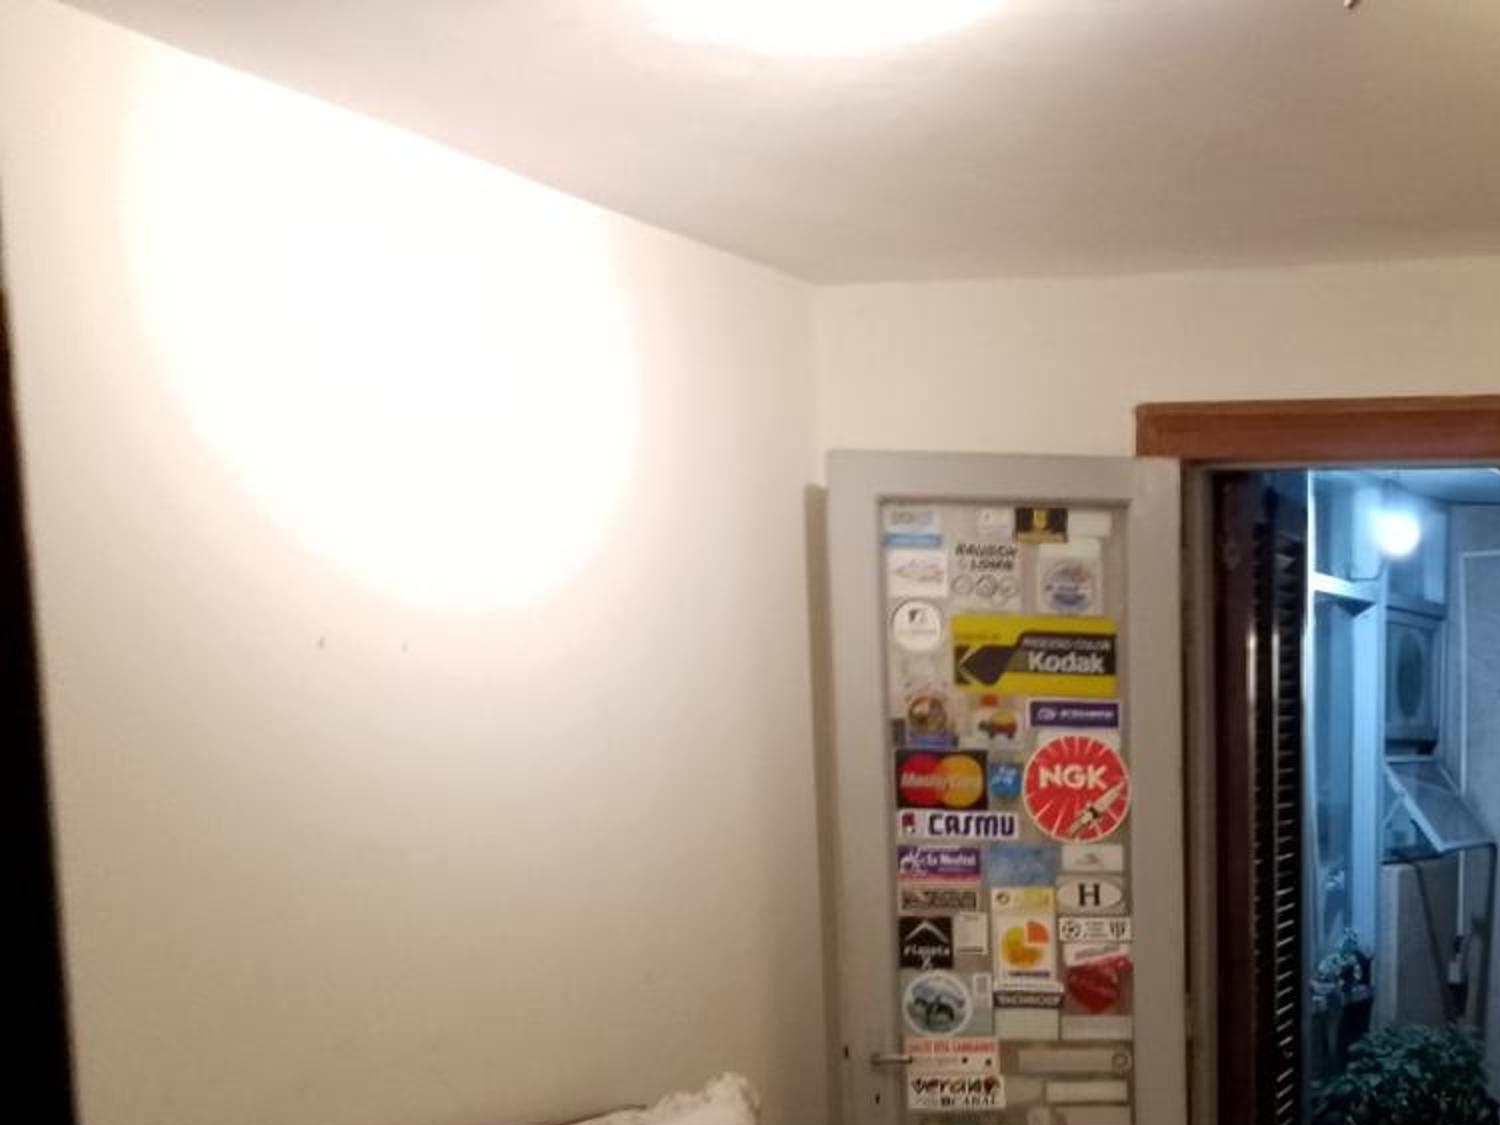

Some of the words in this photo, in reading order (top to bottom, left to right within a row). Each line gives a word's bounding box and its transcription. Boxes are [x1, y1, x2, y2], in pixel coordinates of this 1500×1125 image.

[1028, 651, 1104, 673] Kodak
[1038, 763, 1110, 791] NGK
[928, 813, 1016, 837] CASMU
[1077, 882, 1101, 907] H
